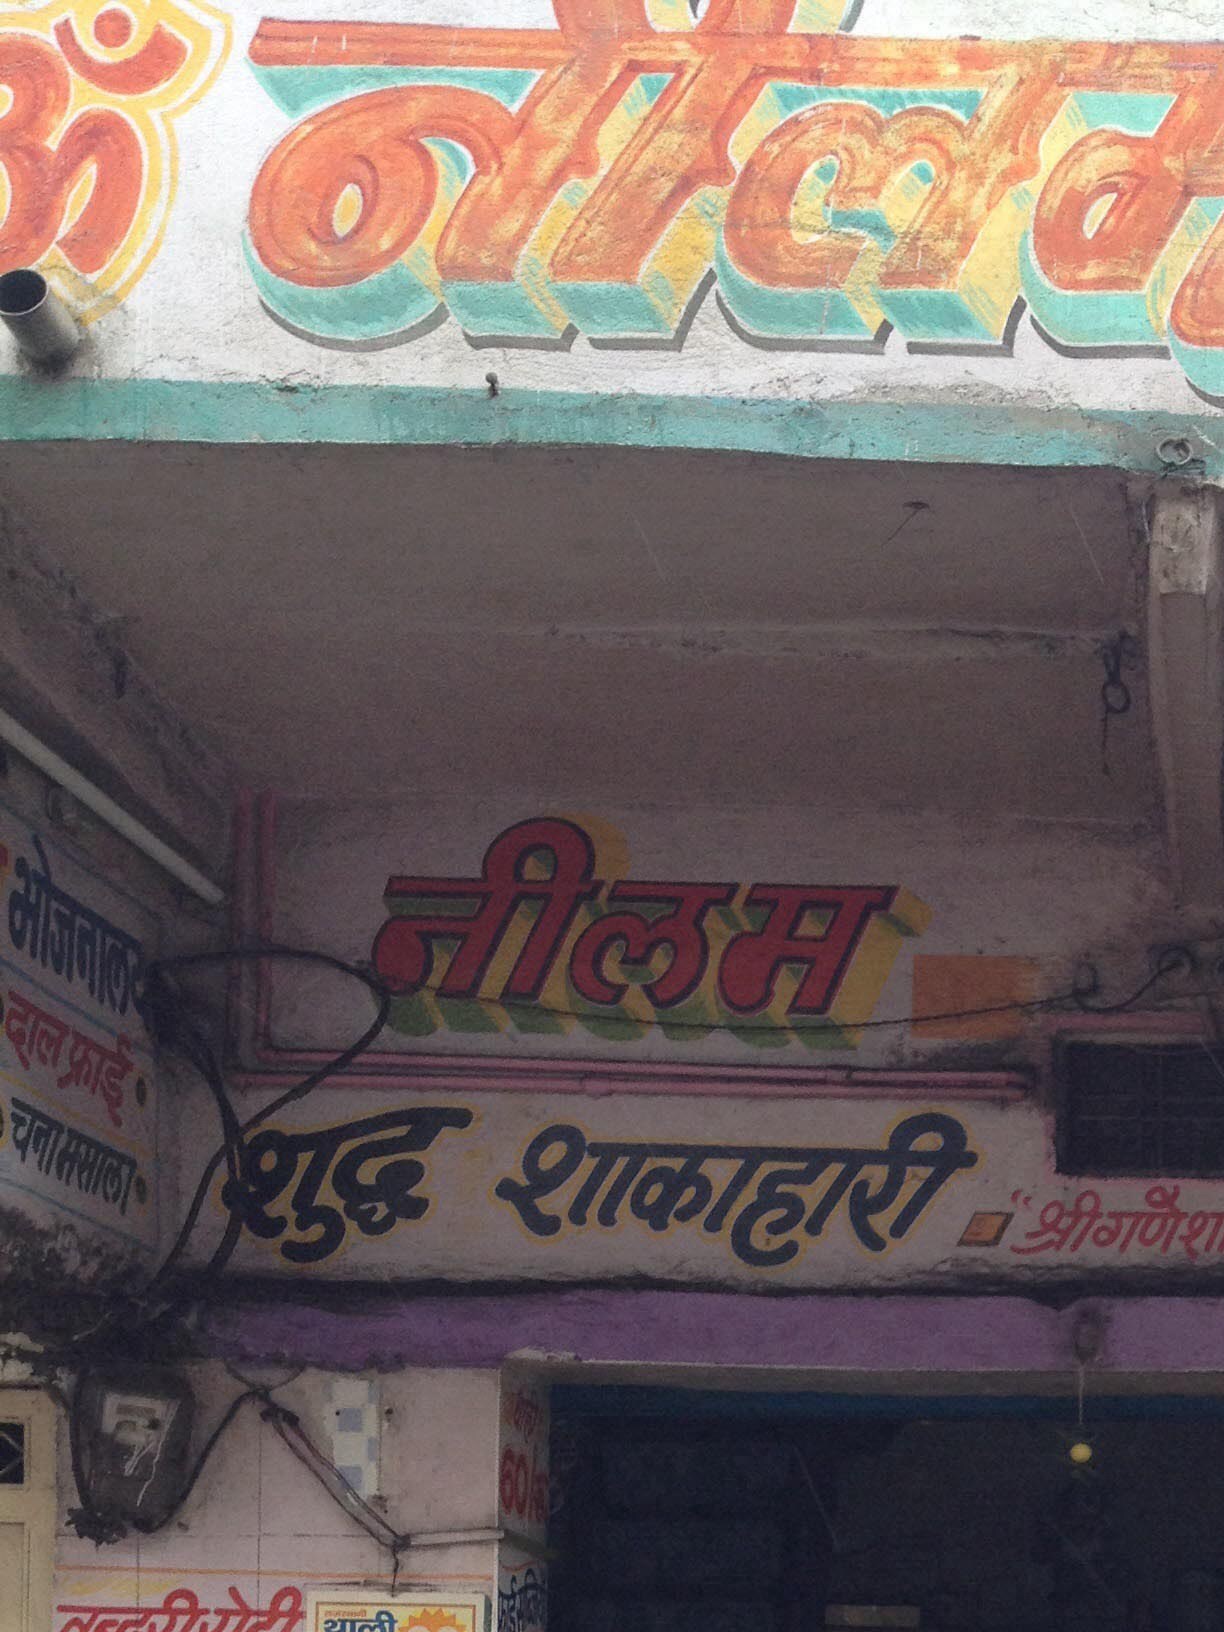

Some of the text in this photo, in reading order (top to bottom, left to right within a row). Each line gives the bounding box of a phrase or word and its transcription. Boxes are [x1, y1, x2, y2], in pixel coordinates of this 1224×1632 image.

[8, 834, 146, 1018] भोजनाल
[370, 815, 900, 1018] नीलम
[4, 990, 70, 1072] दाल
[222, 1106, 979, 1267] शुद्ध शाकाहारी
